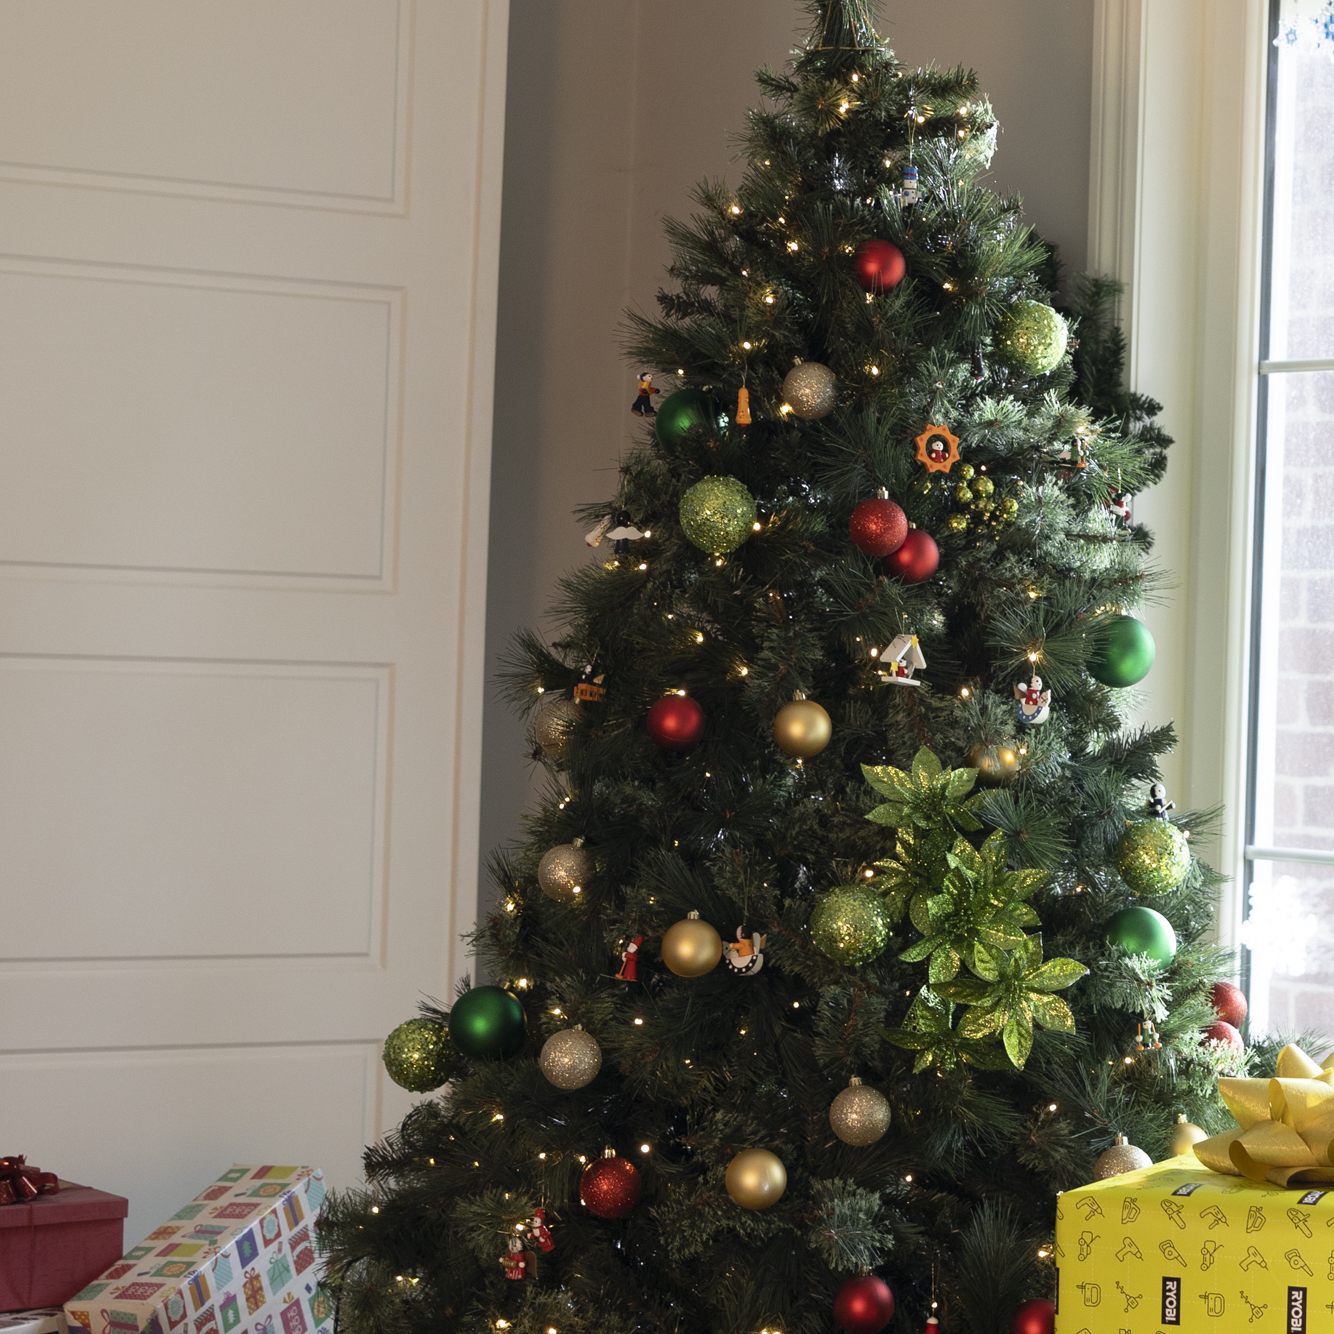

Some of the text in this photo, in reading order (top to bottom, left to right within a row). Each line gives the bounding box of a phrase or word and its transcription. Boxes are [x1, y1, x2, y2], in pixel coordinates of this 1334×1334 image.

[287, 1306, 298, 1319] HO
[1165, 1280, 1177, 1321] RYOBI
[1290, 1290, 1303, 1333] RYOBI
[290, 1315, 300, 1329] HO
